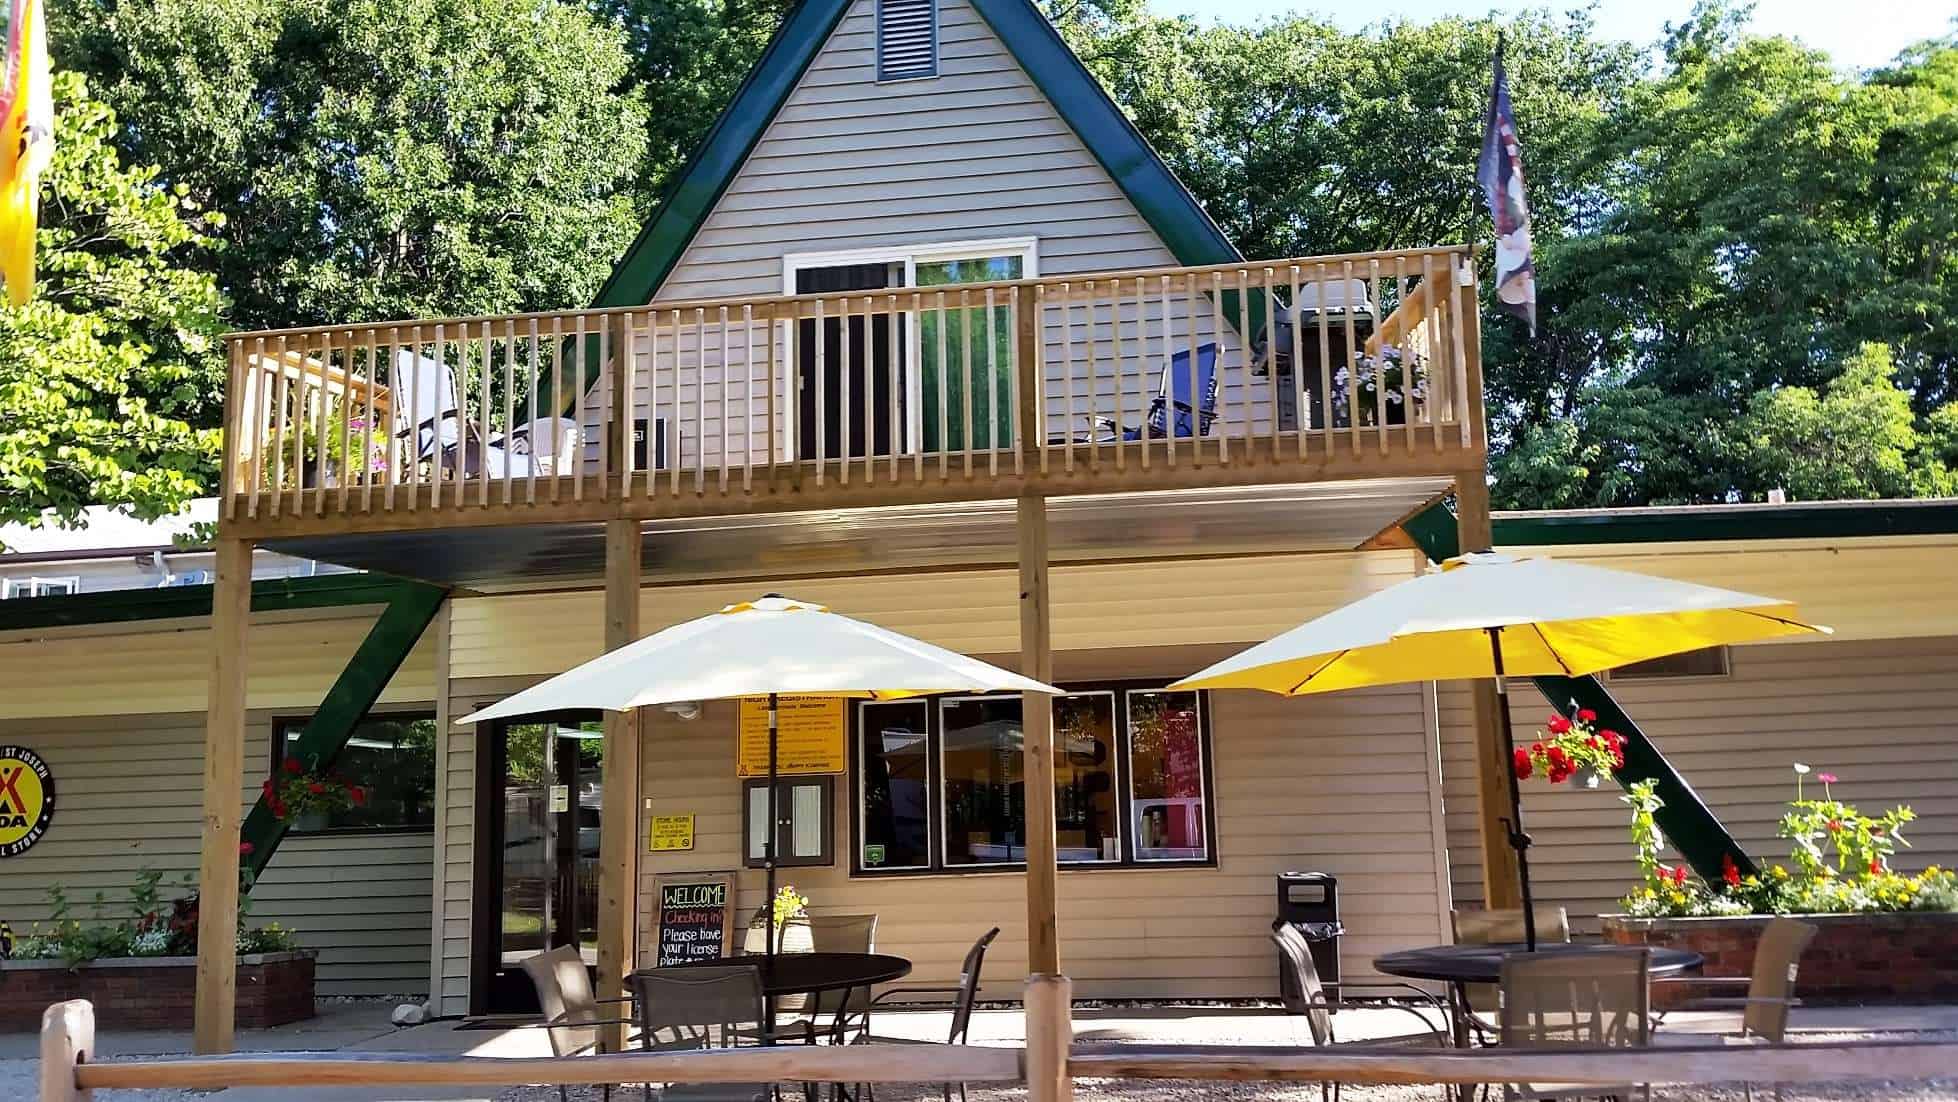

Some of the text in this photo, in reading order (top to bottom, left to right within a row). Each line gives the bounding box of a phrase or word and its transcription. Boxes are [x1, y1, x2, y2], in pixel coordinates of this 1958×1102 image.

[18, 749, 48, 779] JOSEPH
[0, 815, 28, 828] OA
[10, 824, 42, 854] STORE
[664, 885, 727, 905] WELCOME
[665, 910, 707, 928] Checking
[663, 927, 722, 942] Please have
[662, 942, 719, 958] your license
